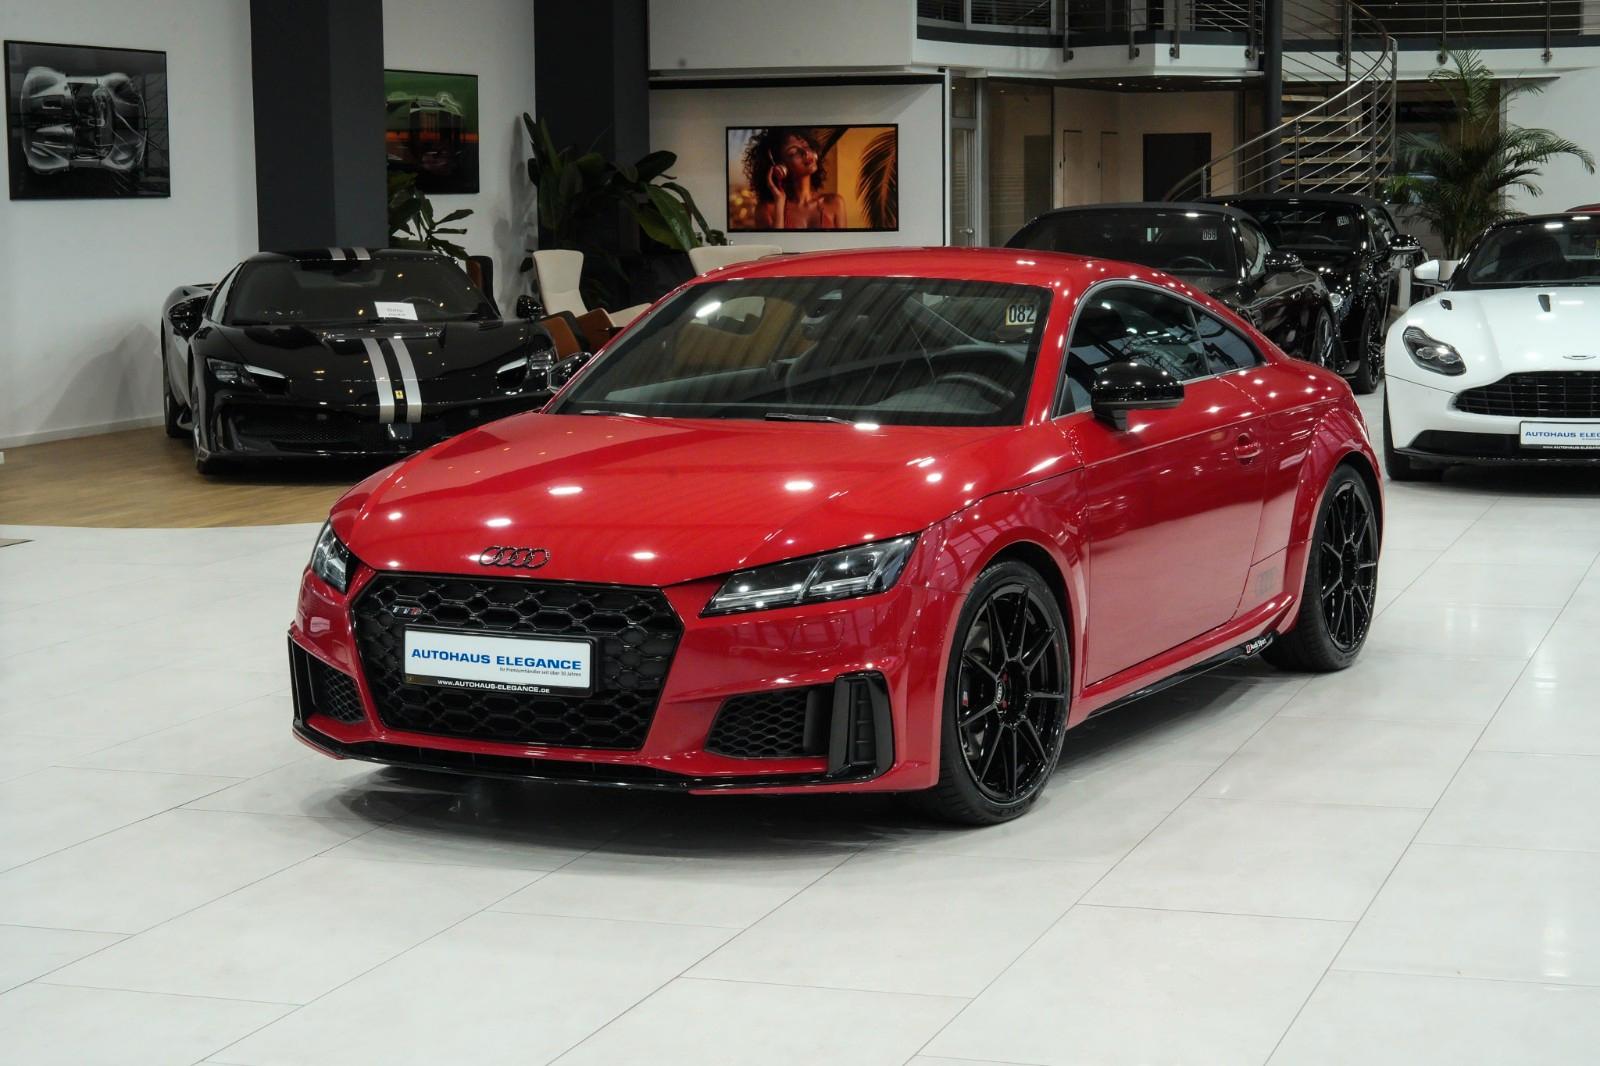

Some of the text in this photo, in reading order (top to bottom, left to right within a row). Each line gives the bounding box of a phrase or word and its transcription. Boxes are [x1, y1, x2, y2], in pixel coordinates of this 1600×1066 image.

[1009, 304, 1035, 323] 082
[411, 648, 582, 670] AUTOHAUS ELEGANCE
